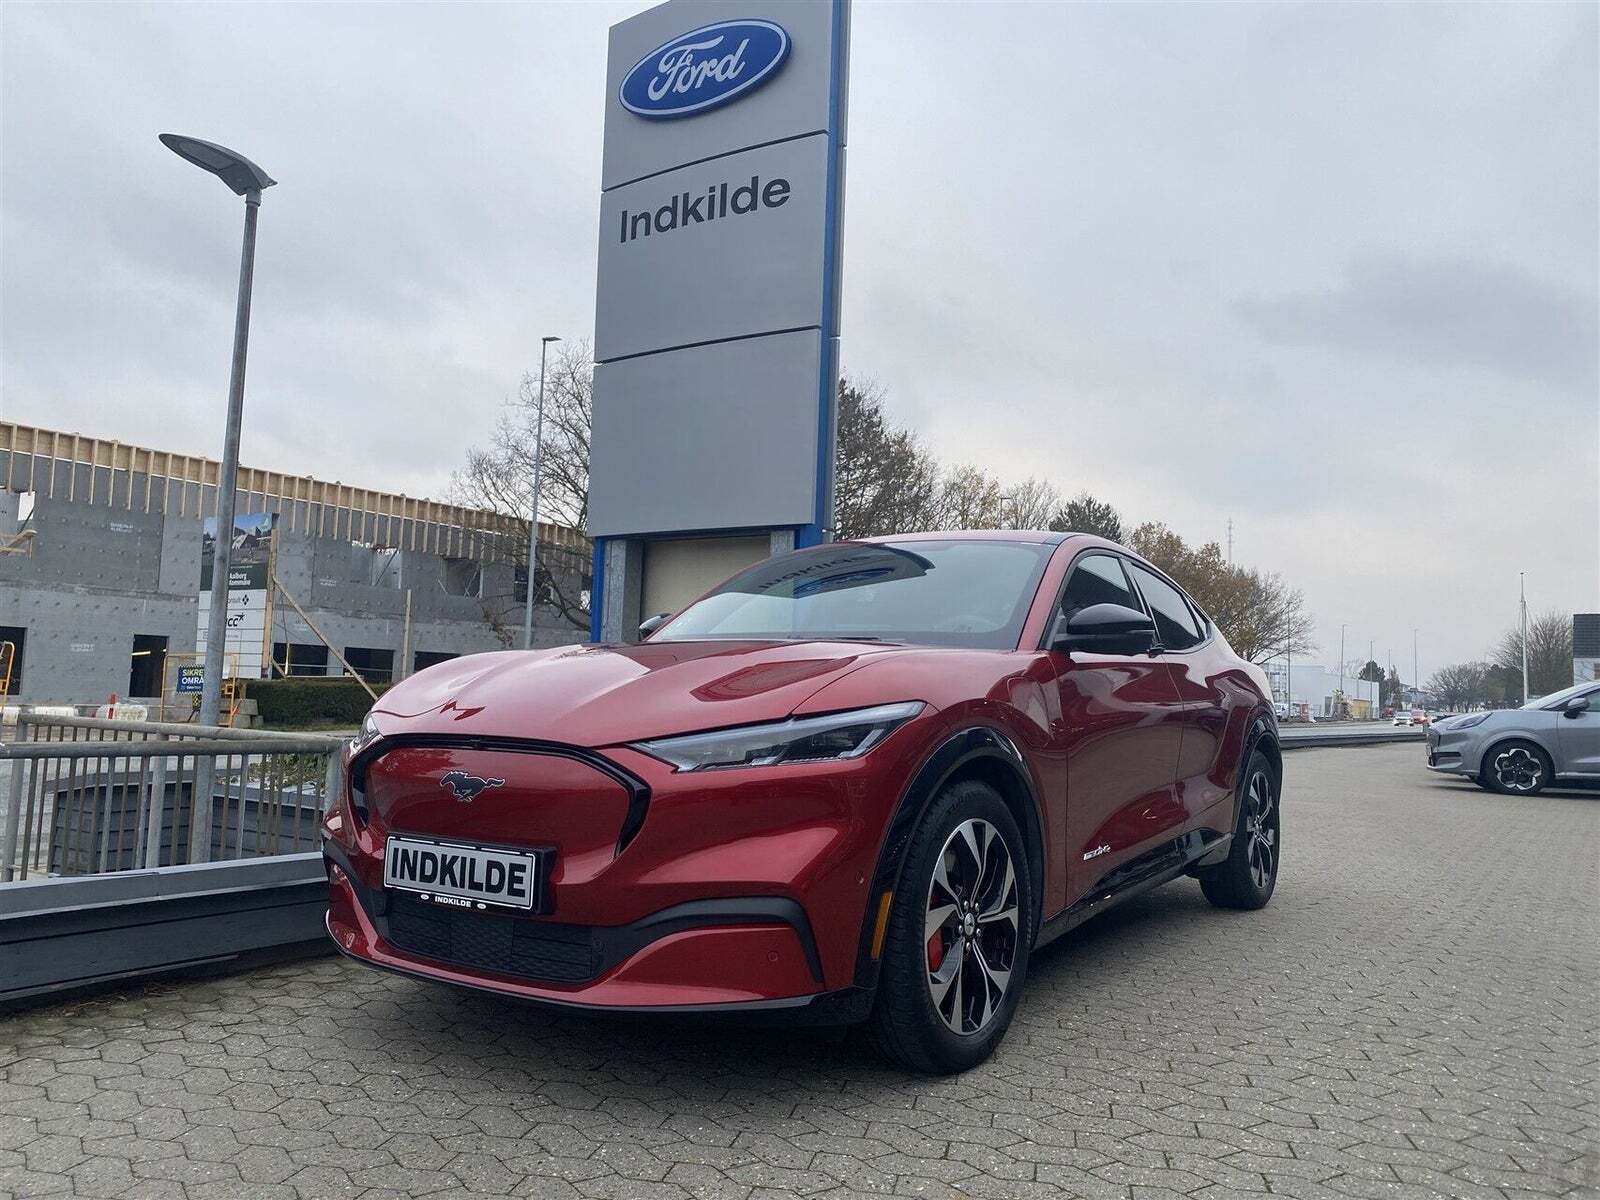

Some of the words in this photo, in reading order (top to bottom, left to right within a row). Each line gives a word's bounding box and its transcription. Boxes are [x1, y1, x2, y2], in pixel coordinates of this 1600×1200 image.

[648, 35, 751, 101] Ford
[620, 175, 791, 243] Indkilde
[226, 618, 239, 627] CC
[182, 669, 204, 677] SIKRE
[391, 847, 527, 898] INDKILDE
[434, 895, 472, 908] INDKILDE
